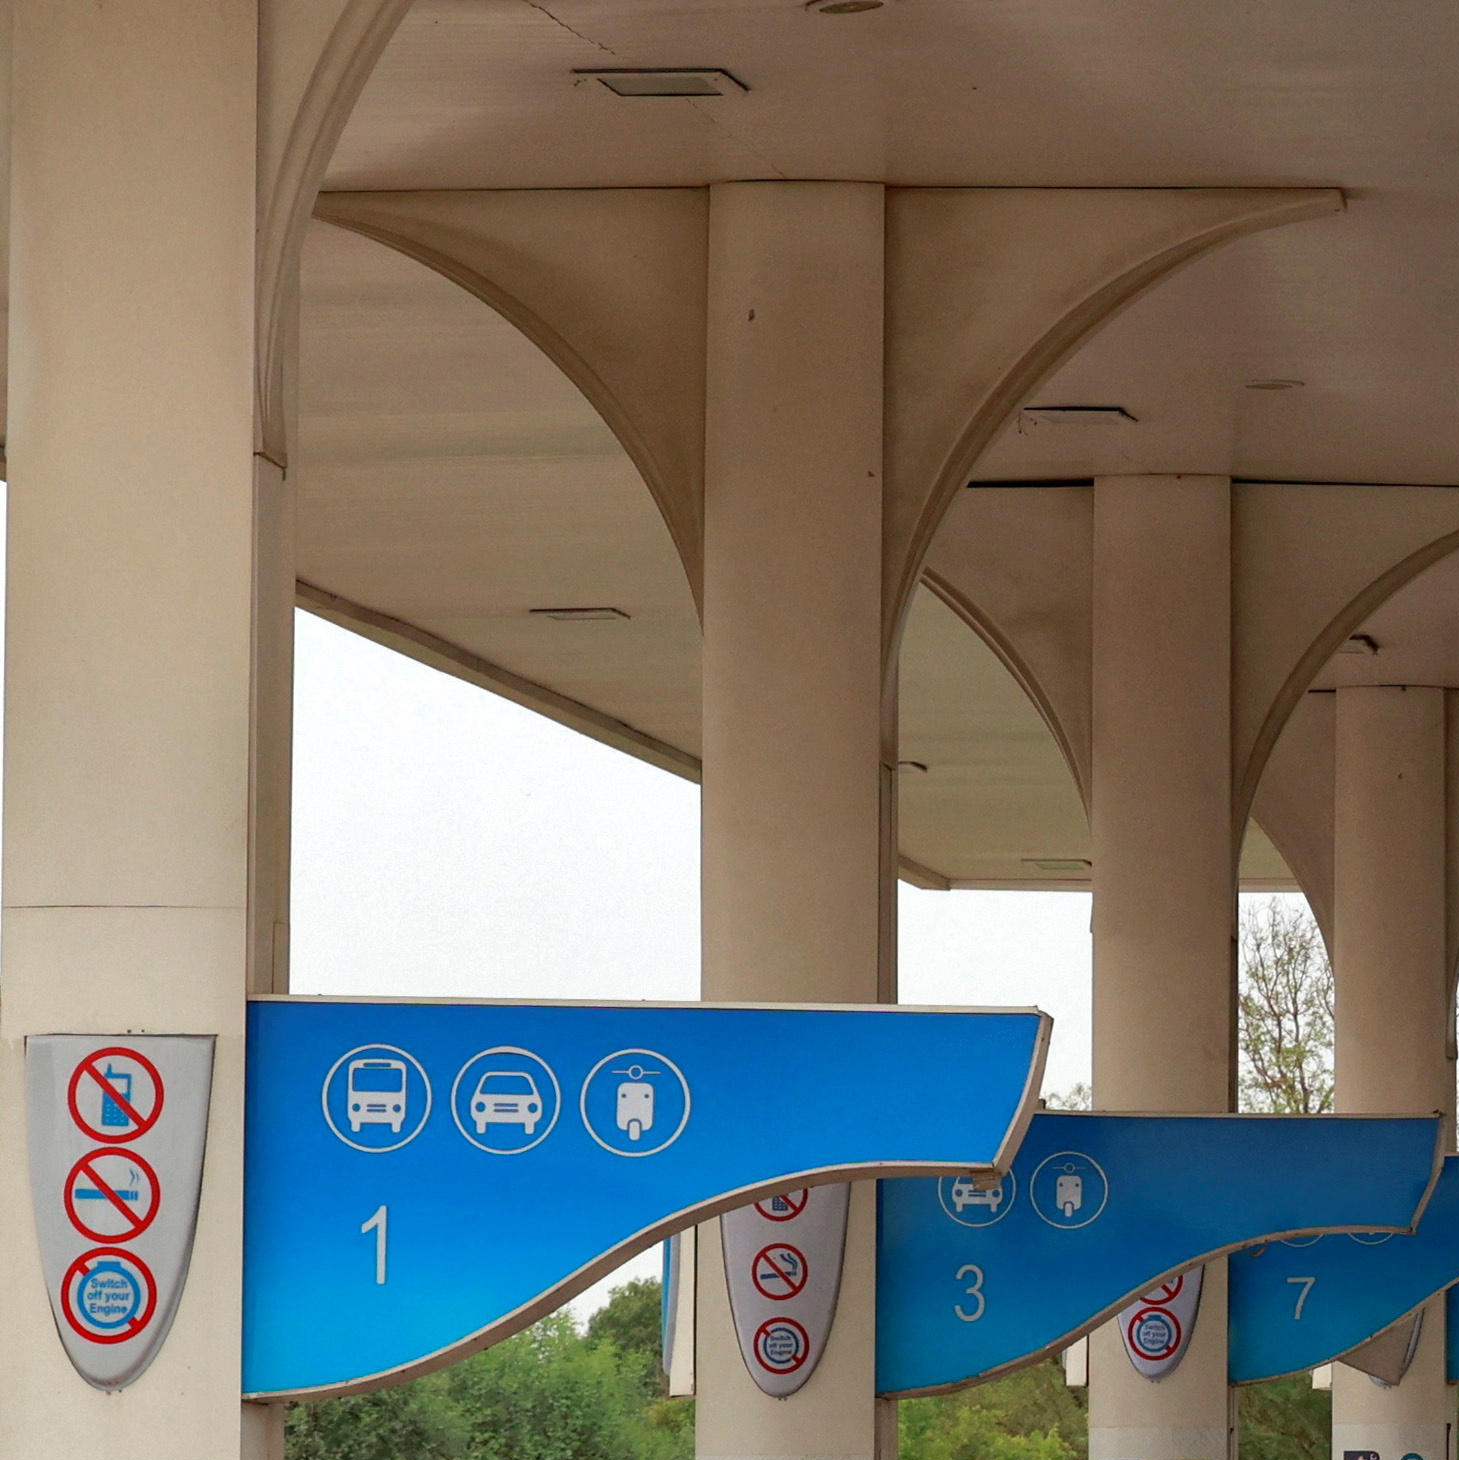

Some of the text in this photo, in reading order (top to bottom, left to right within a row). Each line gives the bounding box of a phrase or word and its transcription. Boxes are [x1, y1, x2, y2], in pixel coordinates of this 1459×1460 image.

[359, 1204, 387, 1286] 1
[87, 1291, 130, 1303] off your
[90, 1278, 127, 1289] Switch
[953, 1264, 986, 1322] 3
[1286, 1276, 1316, 1320] 7
[89, 1303, 127, 1317] Engine
